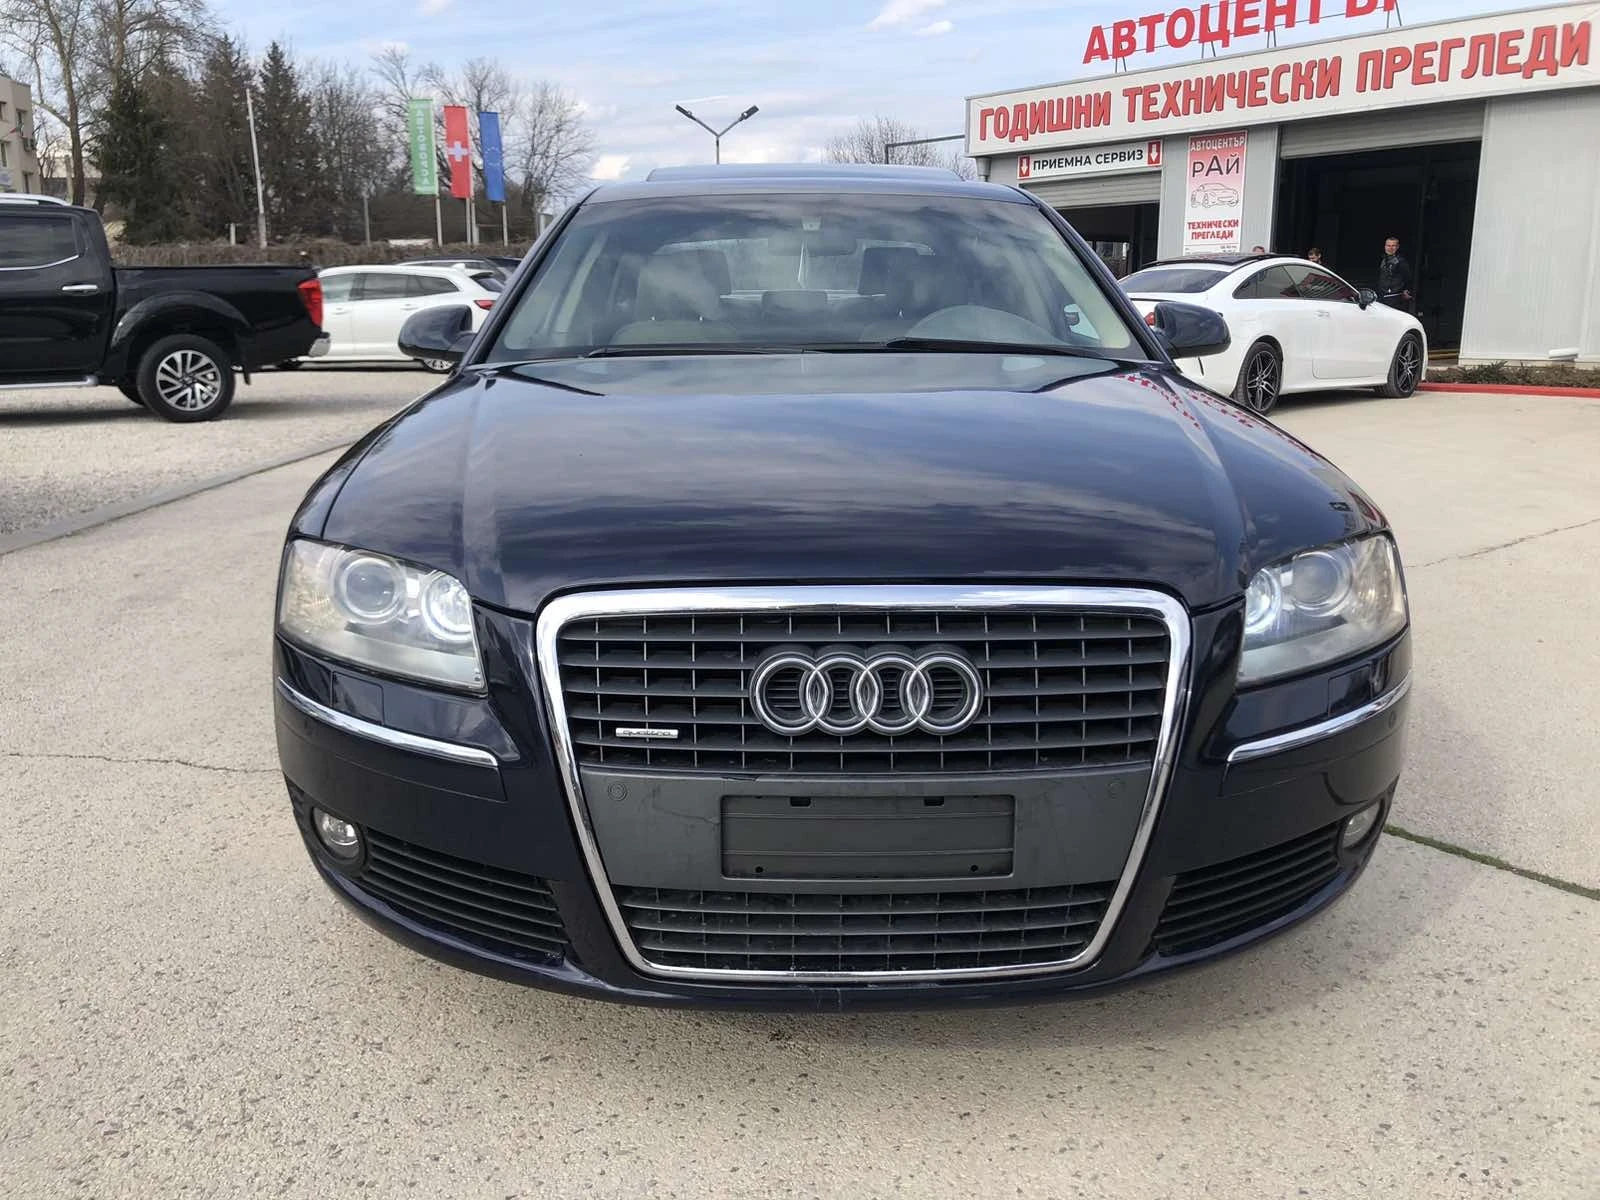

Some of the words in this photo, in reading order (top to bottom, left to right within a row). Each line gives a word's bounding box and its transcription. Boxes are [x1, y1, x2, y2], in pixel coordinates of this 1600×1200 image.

[1083, 0, 1392, 64] АВТОЦЕНТ
[979, 90, 1112, 142] ГОДИШНИ
[1122, 55, 1342, 123] ТЕХНИЧЕСКИ
[1356, 20, 1592, 93] ПРЕГЛЕДИ
[1190, 137, 1245, 152] АВТОЦЕНТЪР
[1033, 155, 1092, 171] ПРИЕМНА
[1095, 149, 1144, 165] СЕРВИЗ
[1187, 219, 1239, 230] ТЕХНИЧЕСКИ
[1191, 229, 1234, 240] ПРЕГЛЕДИ
